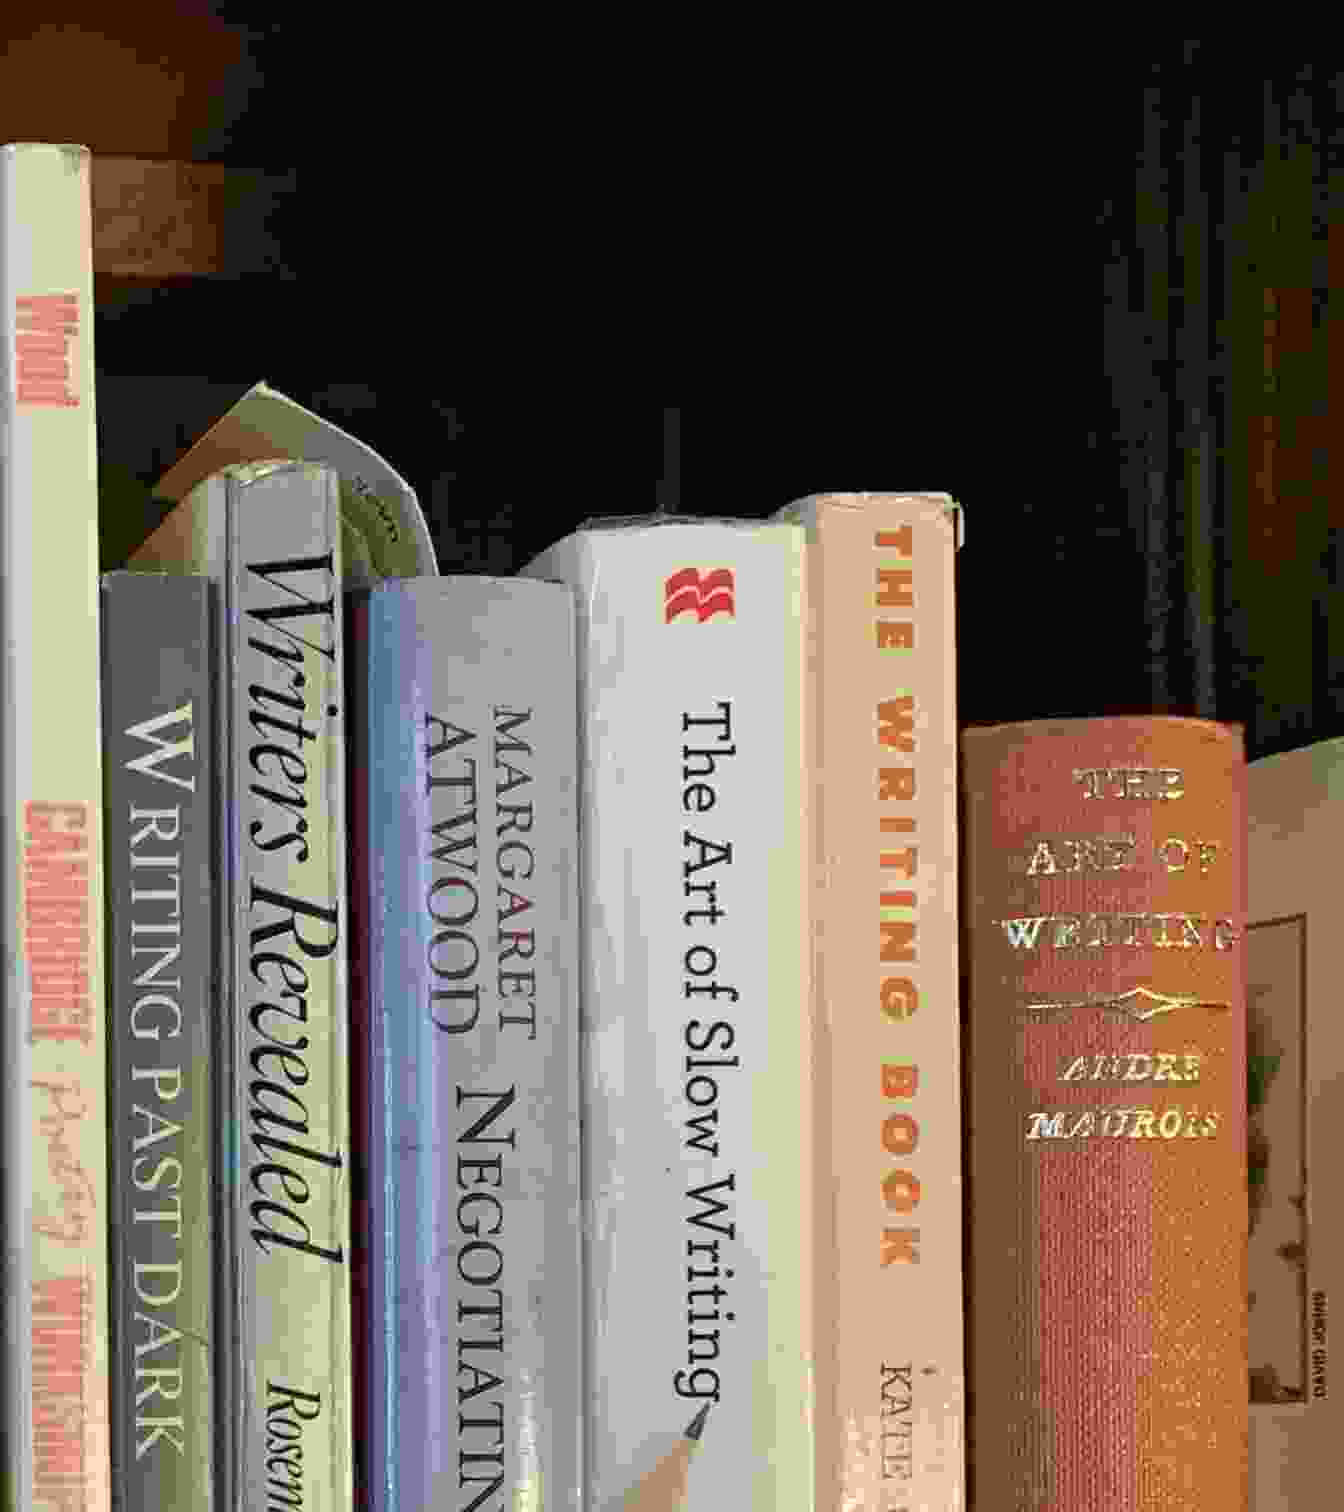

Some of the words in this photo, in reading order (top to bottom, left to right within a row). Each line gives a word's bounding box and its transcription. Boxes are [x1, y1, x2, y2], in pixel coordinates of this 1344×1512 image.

[877, 525, 914, 650] THE
[246, 548, 341, 861] Writers
[683, 702, 734, 812] The
[1074, 769, 1182, 800] THE
[24, 801, 90, 1045] CAMBRIDGE
[123, 702, 196, 1041] WRITING
[424, 712, 482, 1035] ATWOOD
[493, 706, 536, 1040] MARGARET
[685, 832, 732, 925] Art
[877, 697, 918, 1019] WRITING
[994, 913, 1240, 950] WRITING
[246, 880, 343, 1262] Revealed
[685, 944, 739, 1004] of
[132, 1064, 185, 1237] PAST
[685, 1020, 741, 1158] Slow
[878, 1064, 918, 1268] BOOK
[132, 1258, 185, 1462] DARK
[673, 1174, 736, 1403] Writing
[881, 1361, 914, 1481] KATE
